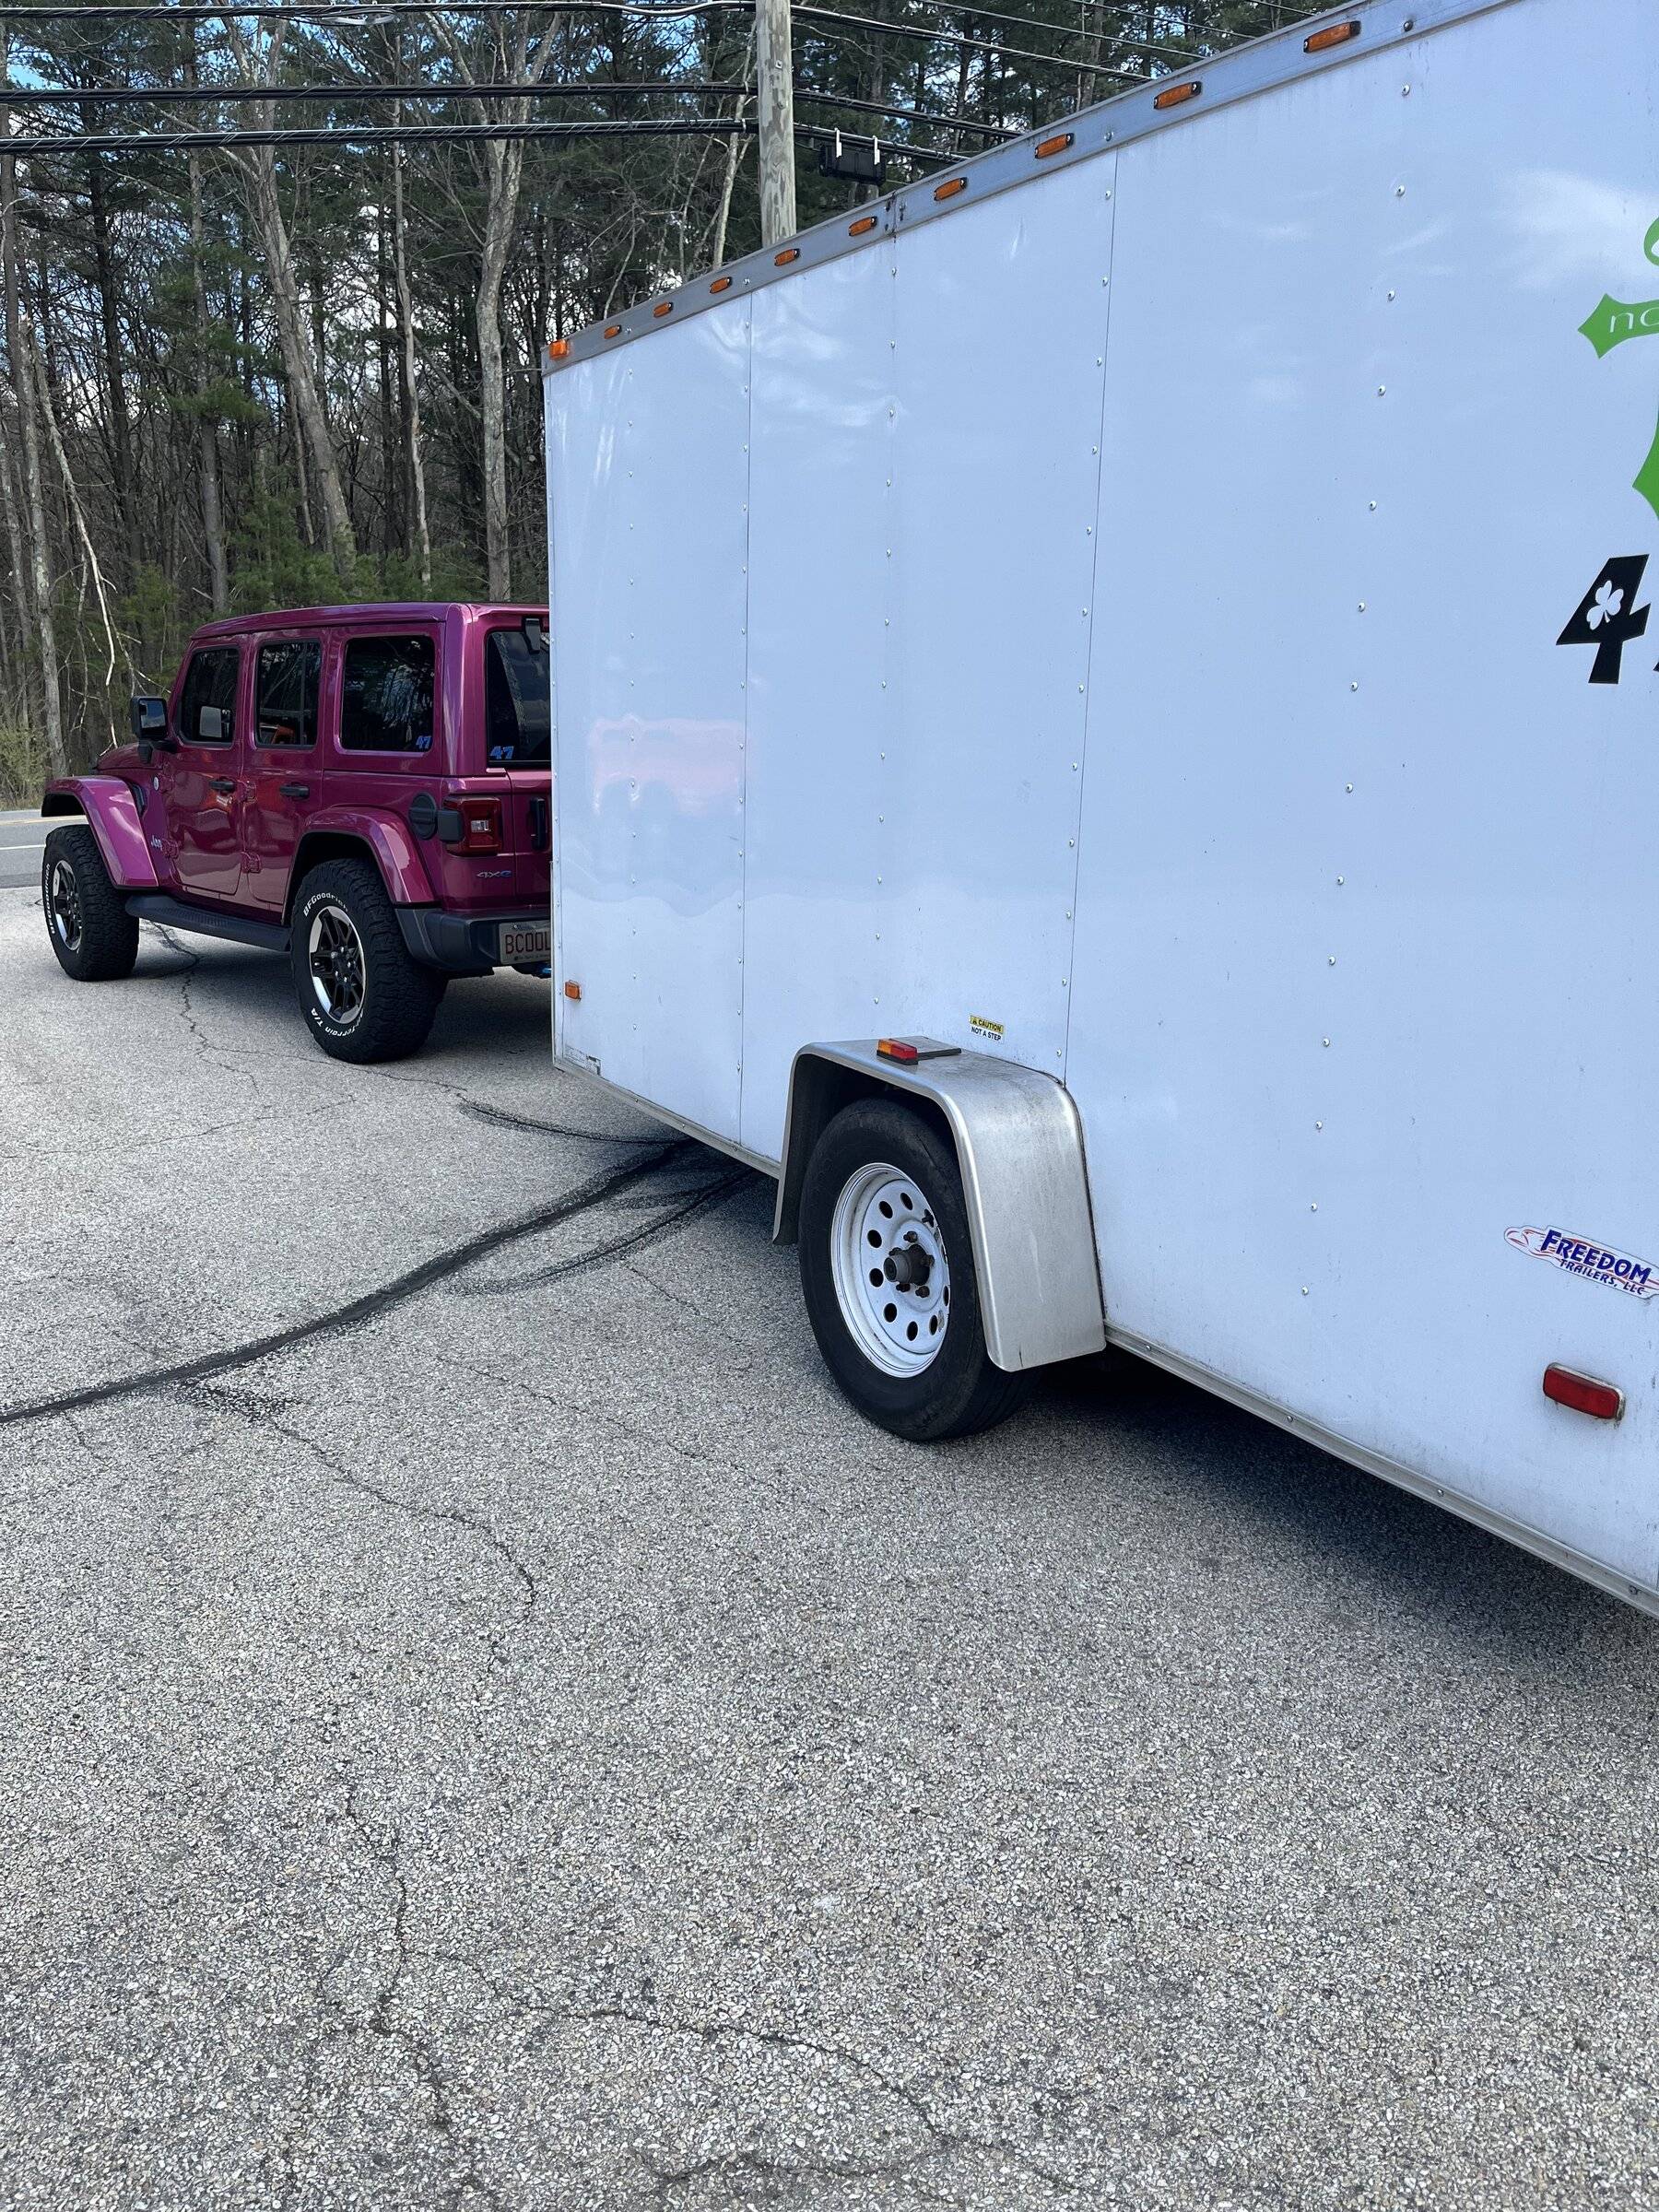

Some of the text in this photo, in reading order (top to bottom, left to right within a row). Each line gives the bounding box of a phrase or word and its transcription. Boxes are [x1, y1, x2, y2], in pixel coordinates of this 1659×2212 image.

[1555, 553, 1659, 685] 4
[416, 735, 432, 749] 47
[490, 746, 514, 759] 47
[302, 891, 349, 917] BFGoodrich
[971, 1026, 982, 1034] NOT
[987, 1031, 1002, 1041] STEP
[978, 1019, 1002, 1032] CAUTION
[1540, 1229, 1653, 1285] FREEDOM
[1559, 1258, 1646, 1295] TRAILERS, LLC
